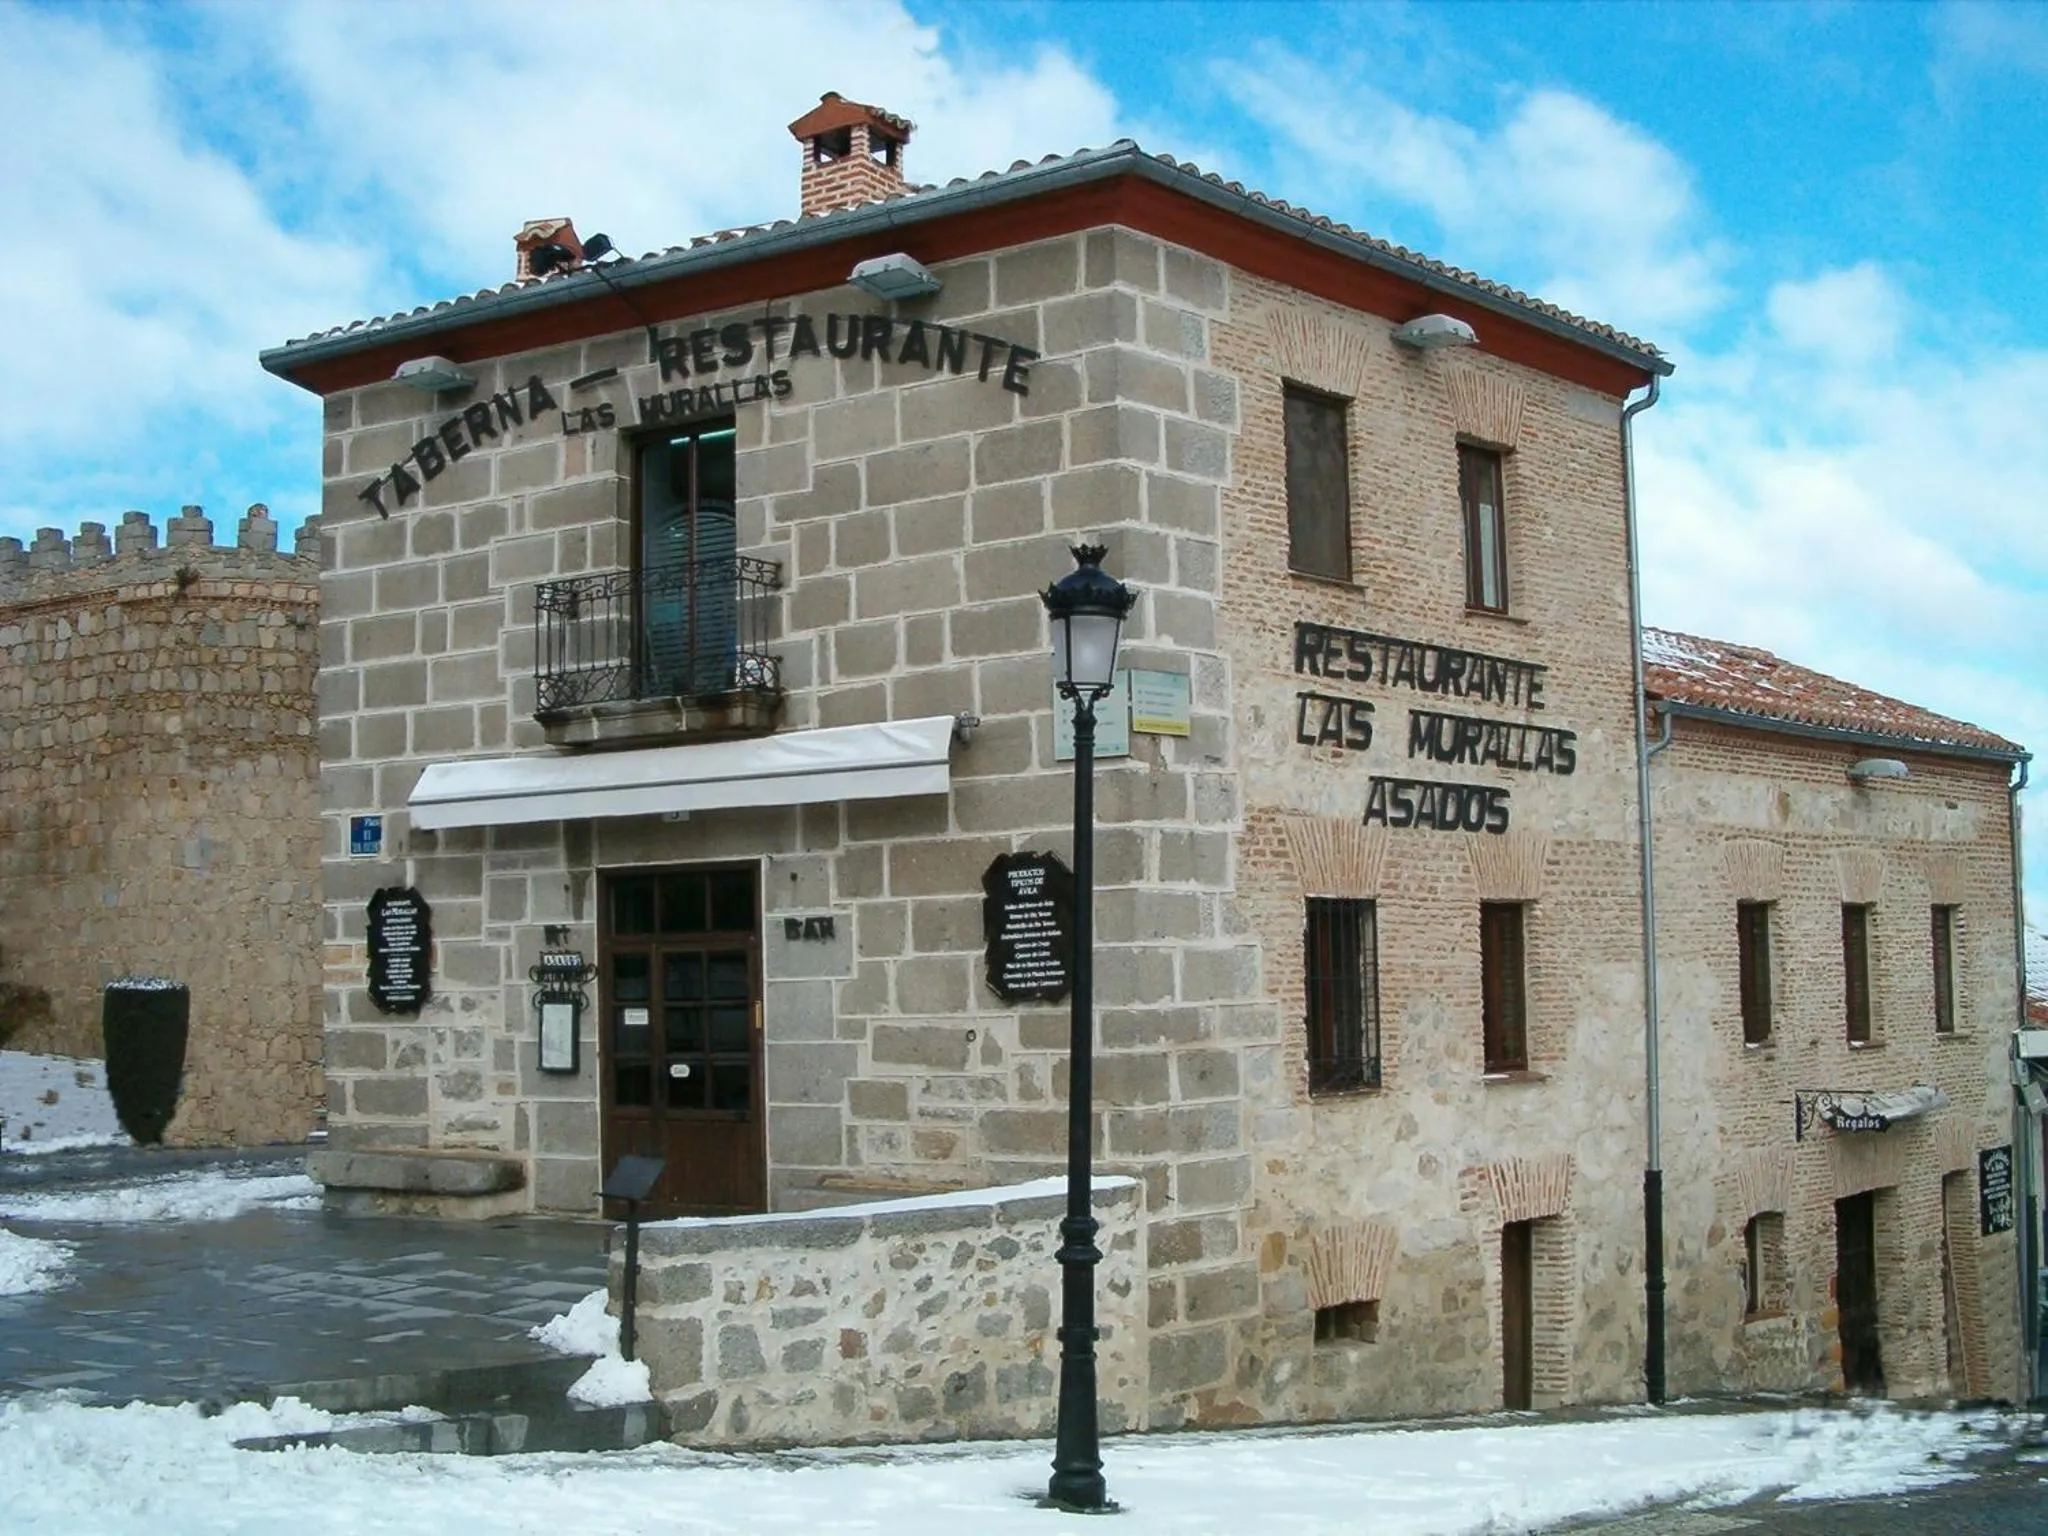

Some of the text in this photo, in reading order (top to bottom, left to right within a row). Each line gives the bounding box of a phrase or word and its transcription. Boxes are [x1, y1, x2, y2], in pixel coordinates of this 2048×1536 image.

[358, 374, 557, 520] TABERNA
[657, 313, 1040, 396] RESTAURANTE
[562, 369, 793, 435] LAS MURALLAS
[1294, 621, 1548, 709] RESTAURANTE
[1296, 692, 1577, 775] LAS MURALLAS
[1363, 776, 1511, 834] ASADOS
[784, 916, 836, 941] BAR
[1836, 1115, 1881, 1132] Regalos
